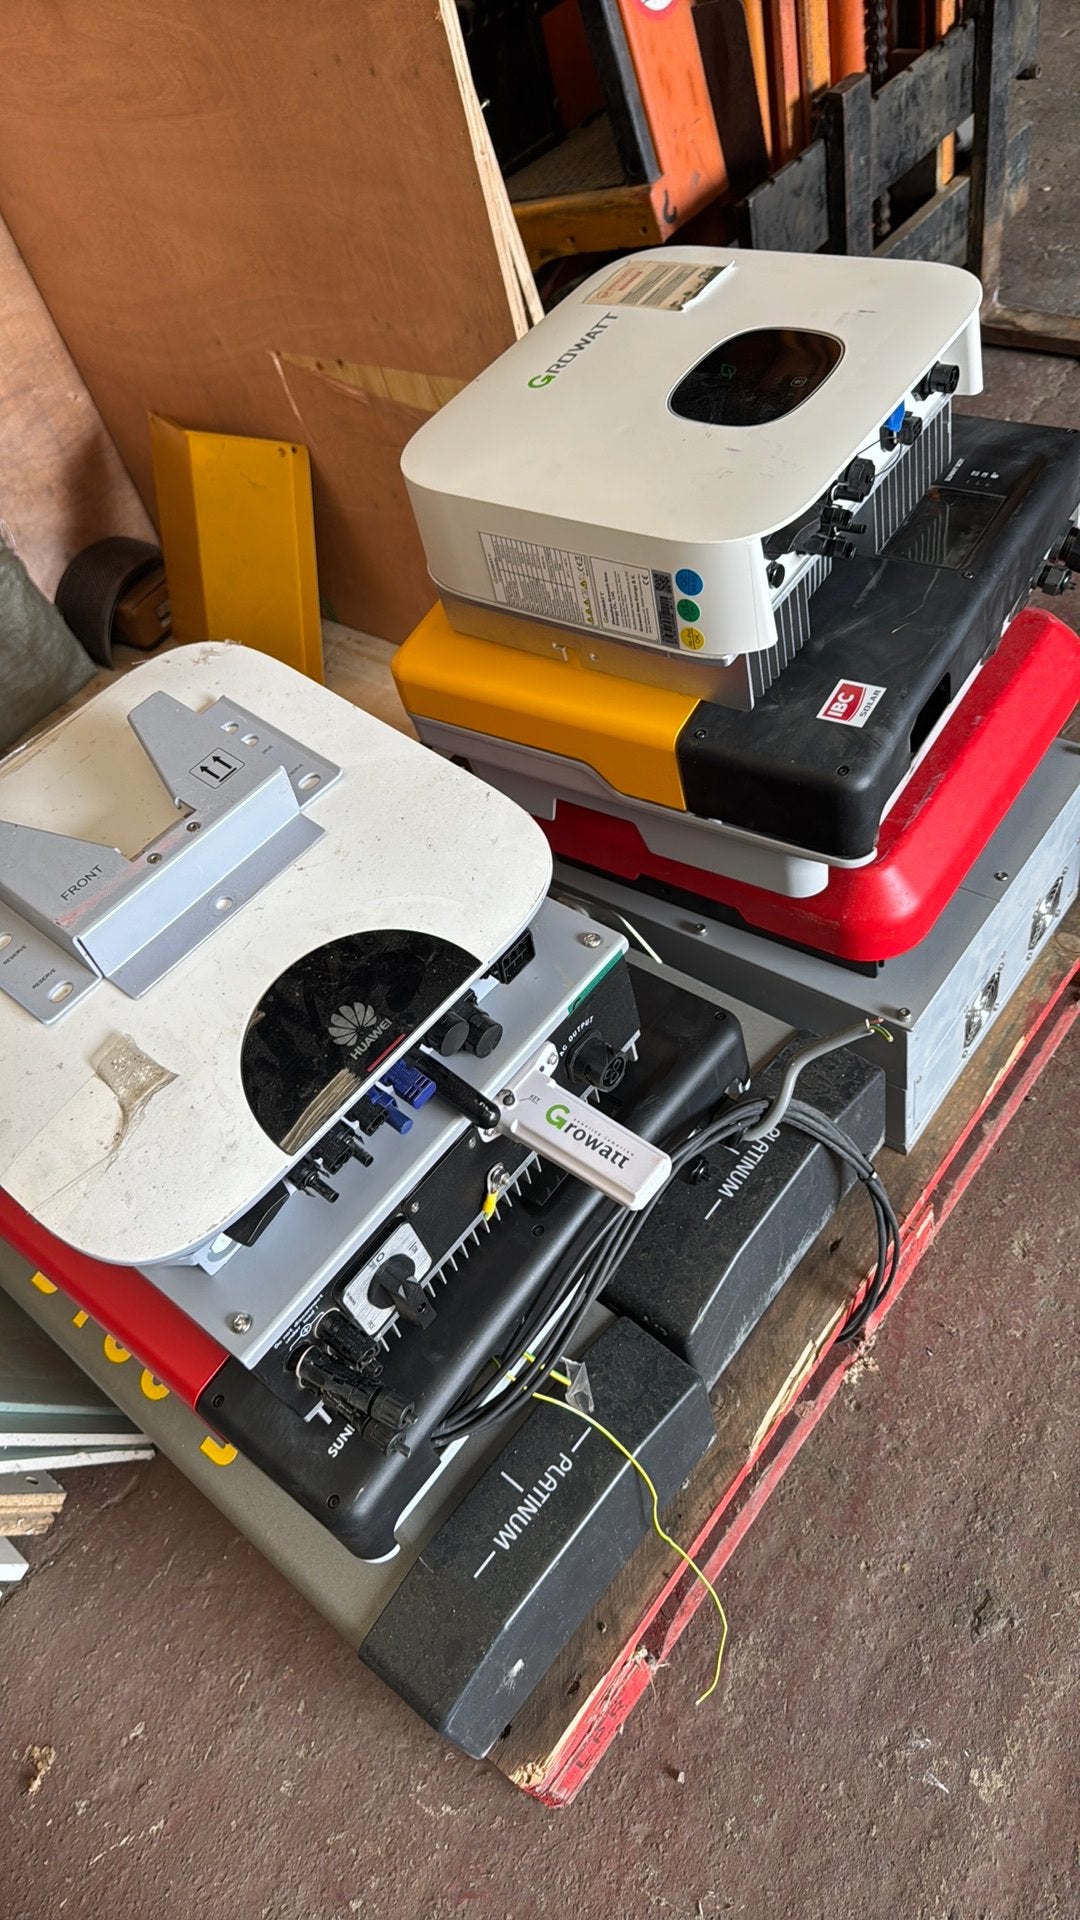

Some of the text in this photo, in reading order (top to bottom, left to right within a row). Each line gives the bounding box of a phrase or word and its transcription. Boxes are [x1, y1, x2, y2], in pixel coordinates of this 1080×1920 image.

[528, 311, 618, 389] GROWATT
[826, 692, 854, 718] IBC
[860, 690, 881, 717] SOLAR
[60, 864, 102, 901] FRONT
[3, 944, 27, 965] RESERVE
[32, 968, 56, 989] RESERVE
[350, 1017, 393, 1060] HUAWEI
[559, 1044, 568, 1057] AC
[568, 1015, 594, 1042] OUTPUT
[529, 1094, 541, 1104] KEY
[545, 1104, 631, 1169] Growatt
[274, 1294, 324, 1349] Do not disconnect
[285, 1322, 301, 1344] under
[493, 1452, 573, 1550] PLATINUM
